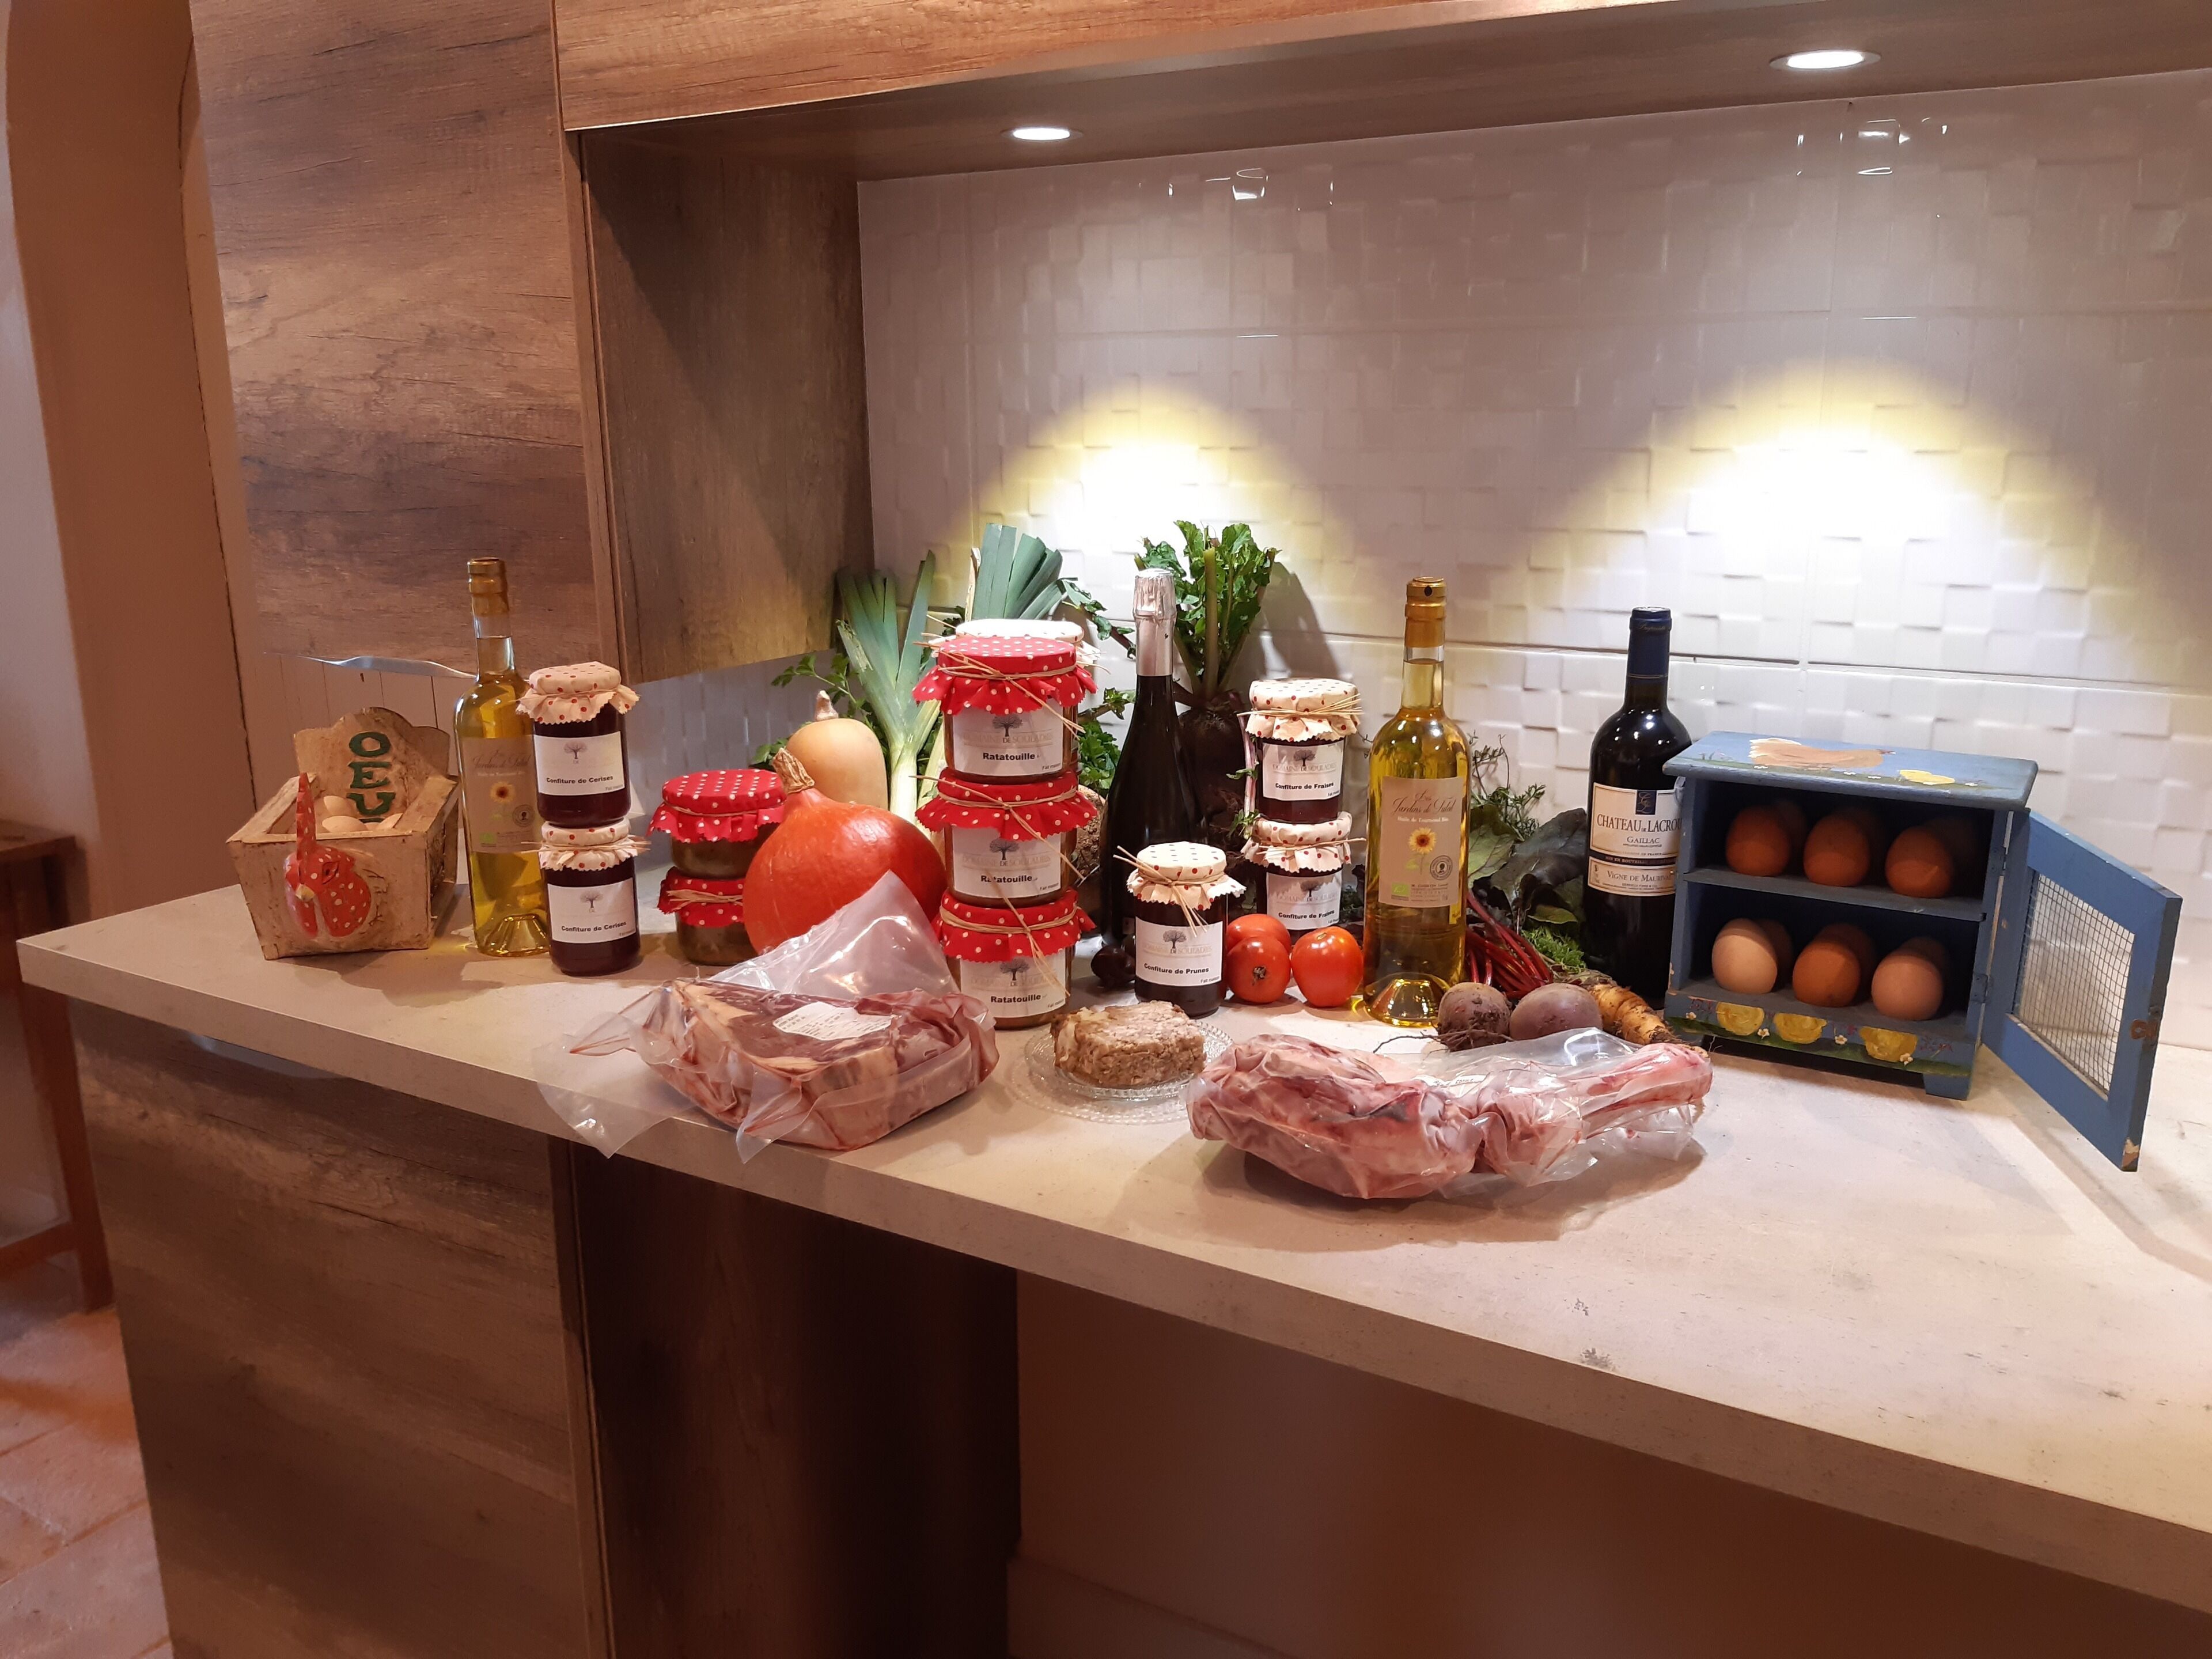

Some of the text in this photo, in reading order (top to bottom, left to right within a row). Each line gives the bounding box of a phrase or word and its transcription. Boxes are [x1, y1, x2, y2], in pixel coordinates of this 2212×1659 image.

[983, 752, 1035, 761] Ratatouille
[347, 731, 396, 823] OEU
[589, 775, 613, 783] Cerises
[1597, 813, 1641, 832] CHATEAU
[1626, 836, 1660, 844] GAILLAC
[1607, 870, 1627, 881] VIGNE
[604, 922, 627, 930] Cerises
[1144, 963, 1173, 974] Confiture
[991, 994, 1041, 1003] Ratatouille
